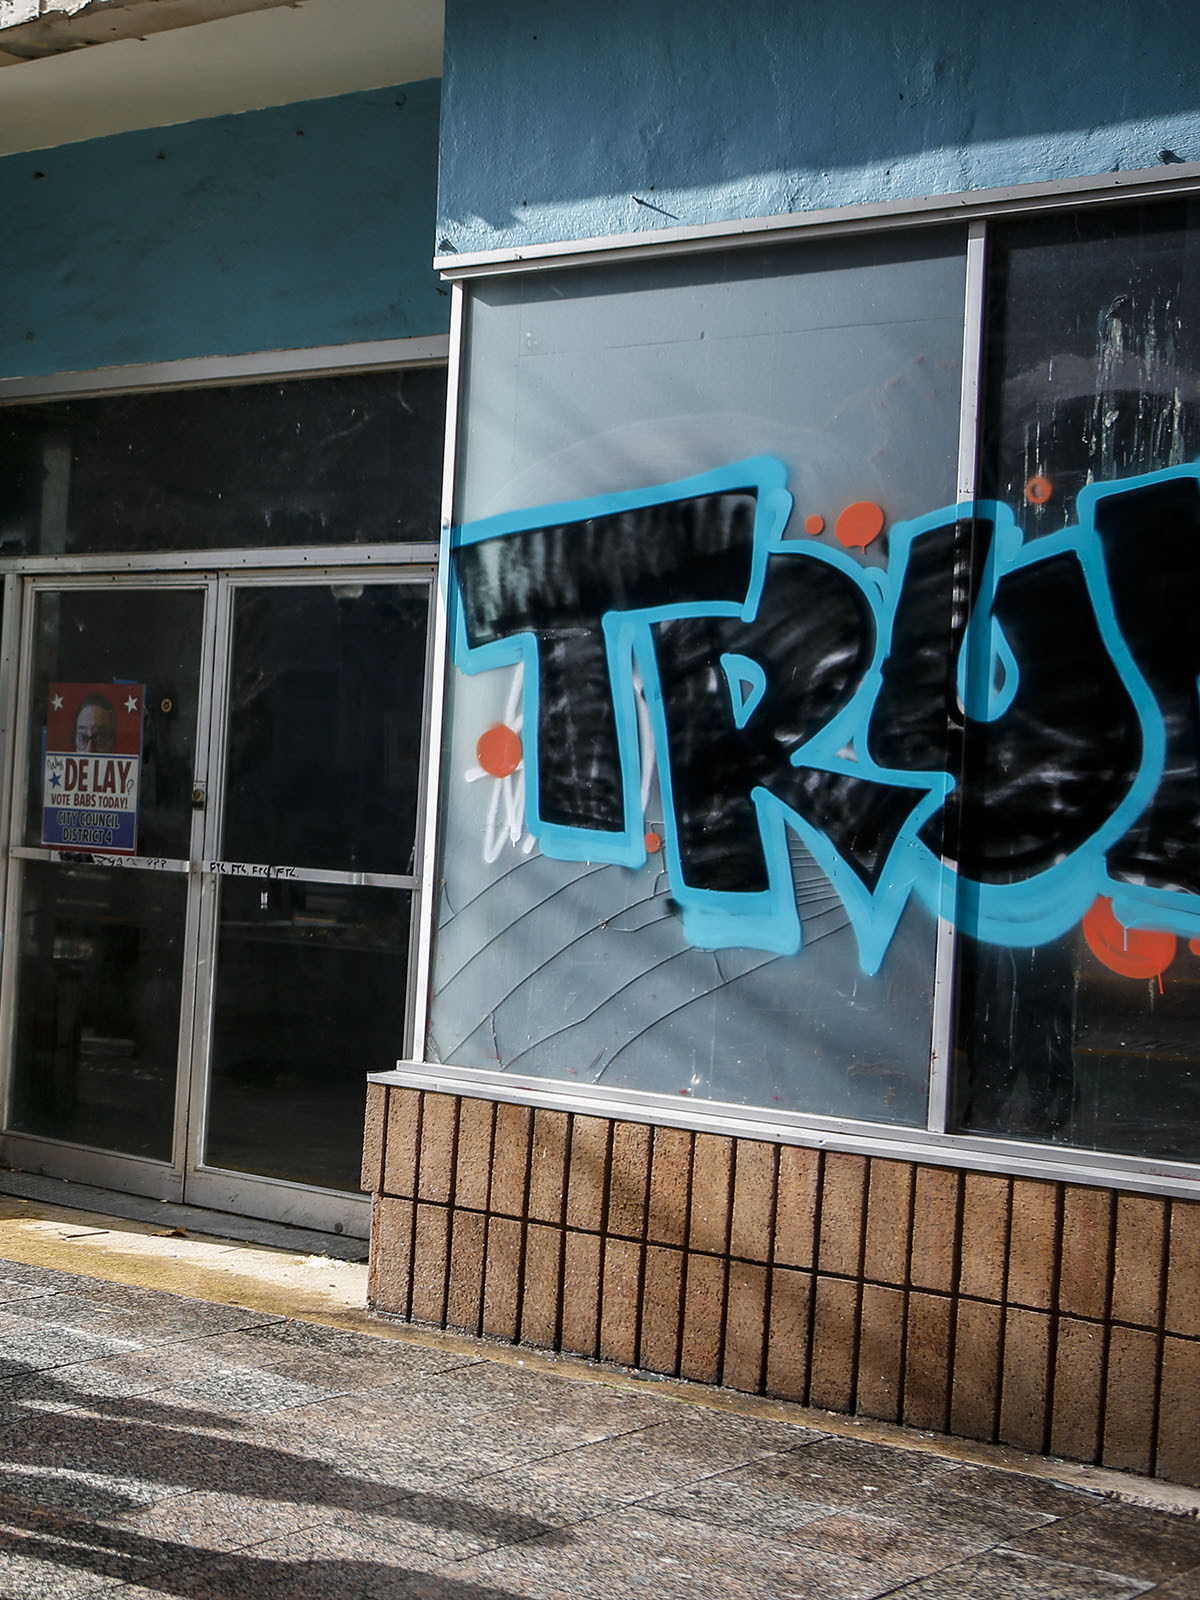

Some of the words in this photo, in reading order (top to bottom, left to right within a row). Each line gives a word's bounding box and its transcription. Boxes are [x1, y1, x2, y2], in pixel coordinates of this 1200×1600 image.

[443, 455, 1200, 977] TRU
[51, 793, 71, 806] VOTE
[73, 793, 97, 807] BABS
[98, 795, 128, 809] TODAY!
[57, 810, 78, 825] CITY
[80, 811, 120, 829] COUNCIL
[63, 827, 103, 844] DISTRICT
[105, 830, 113, 845] 4
